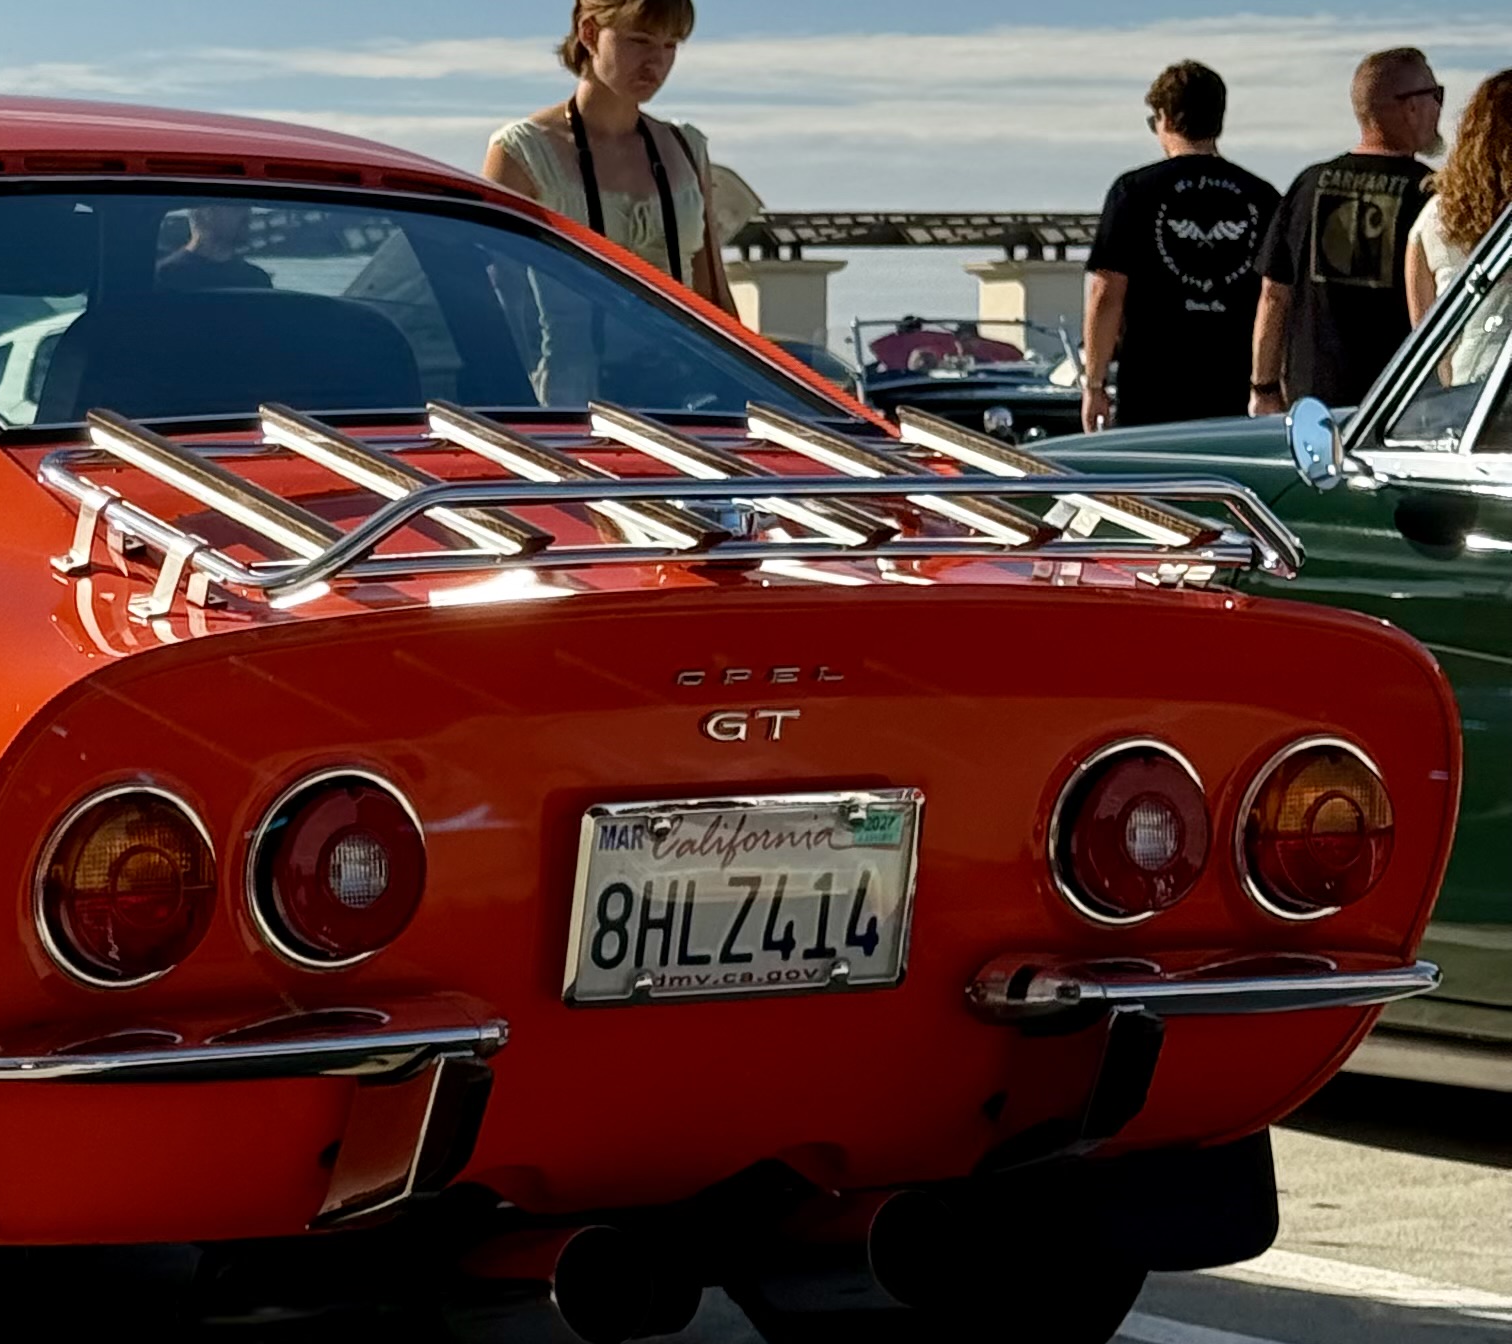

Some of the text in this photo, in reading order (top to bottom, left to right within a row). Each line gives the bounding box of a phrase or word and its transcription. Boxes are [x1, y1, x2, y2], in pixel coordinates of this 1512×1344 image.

[676, 666, 846, 686] OPEL
[704, 709, 801, 742] GT
[598, 824, 645, 851] MAR
[652, 814, 848, 870] California
[591, 870, 880, 970] 8HLZ414
[653, 967, 820, 989] dmv.ca.gov
